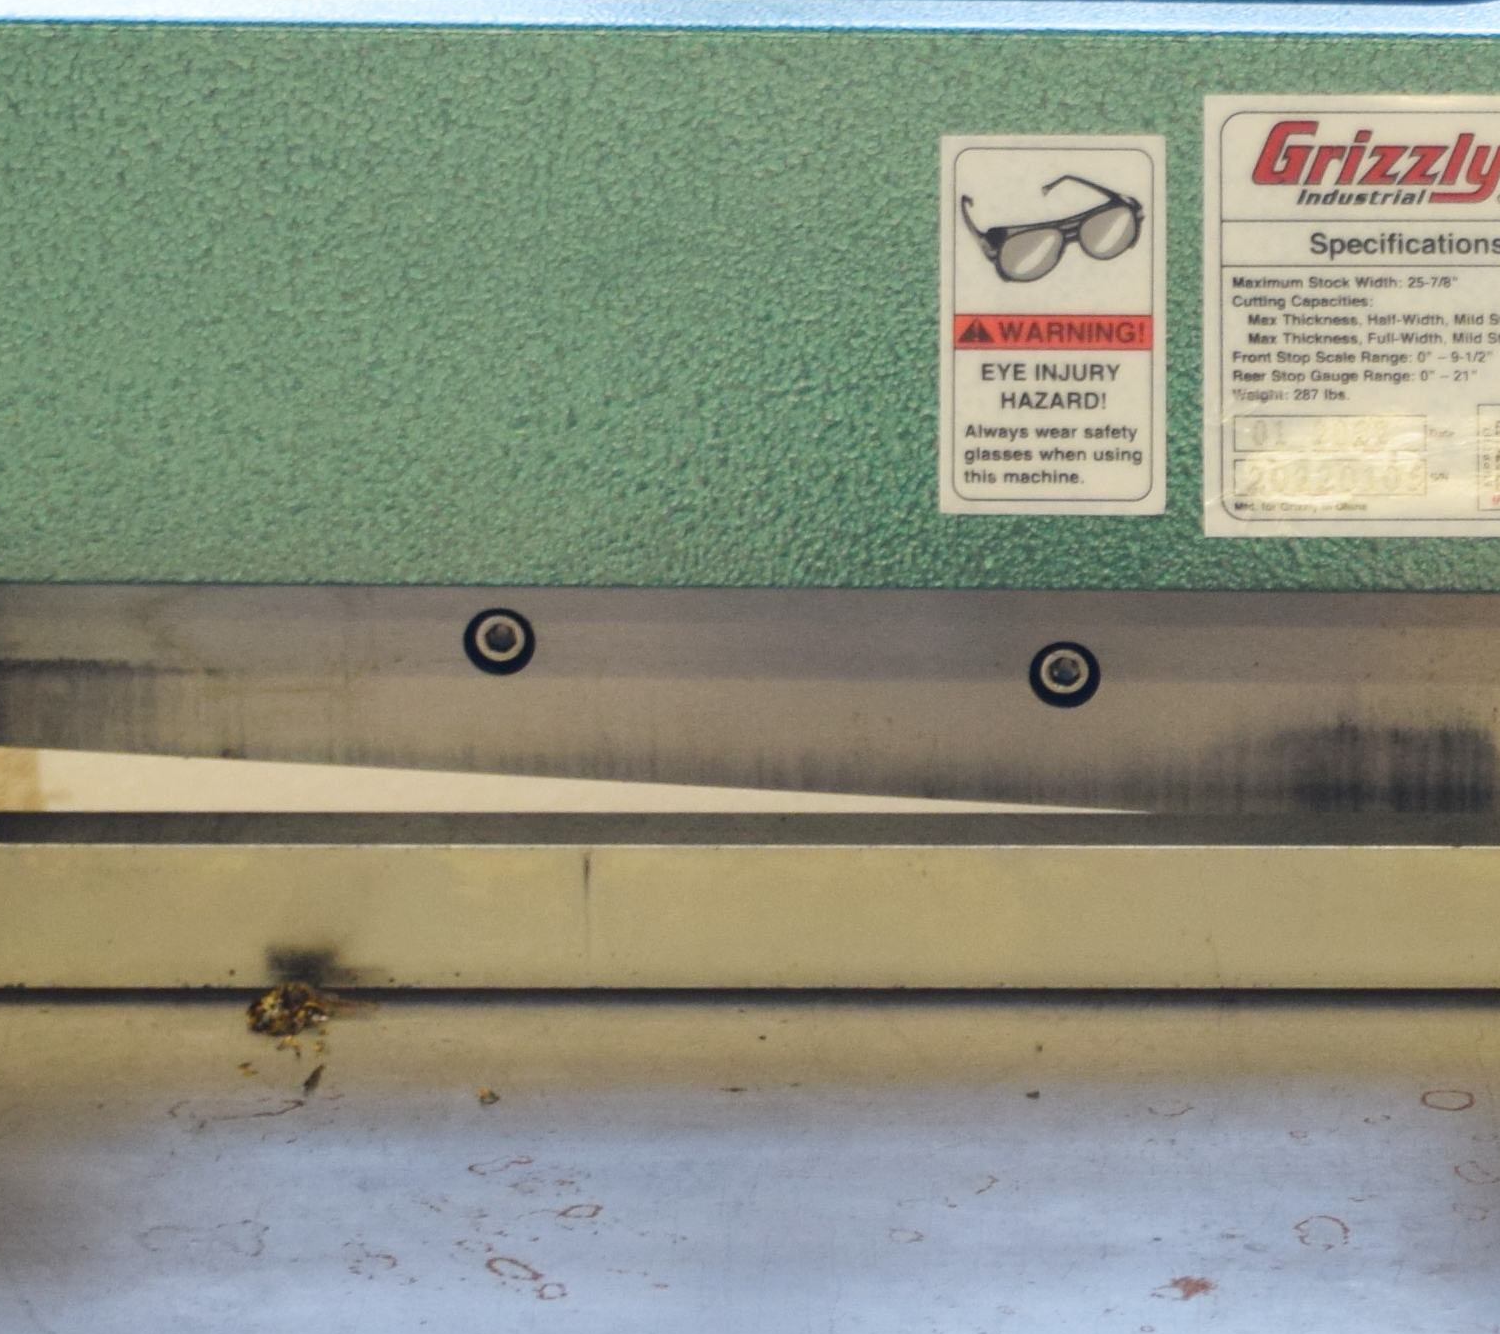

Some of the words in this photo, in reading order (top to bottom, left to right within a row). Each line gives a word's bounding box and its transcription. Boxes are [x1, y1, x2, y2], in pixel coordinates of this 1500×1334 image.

[1296, 189, 1428, 205] Industrial
[1232, 276, 1304, 289] Maximum
[1308, 275, 1350, 289] Stock
[1231, 295, 1286, 311] Cutting
[1248, 313, 1277, 326] Max
[1453, 313, 1484, 325] Mild
[998, 321, 1144, 344] WARNING!
[1248, 332, 1278, 345] Max
[1452, 331, 1482, 344] Mild
[1232, 350, 1272, 364] Front
[1276, 350, 1311, 365] Stop
[1315, 350, 1356, 363] Scale
[981, 363, 1026, 381] EYE
[1035, 363, 1120, 382] INJURY
[1232, 369, 1267, 383] Rear
[1271, 369, 1306, 383] Stop
[1310, 369, 1359, 385] Gauge
[1001, 391, 1106, 410] HAZARD!
[1293, 387, 1319, 401] 287
[965, 424, 1029, 443] Always
[1034, 427, 1078, 439] wear
[1084, 424, 1138, 443] safety
[964, 447, 1033, 465] glasses
[1038, 447, 1087, 462] when
[1093, 447, 1143, 466] using
[964, 469, 997, 484] this
